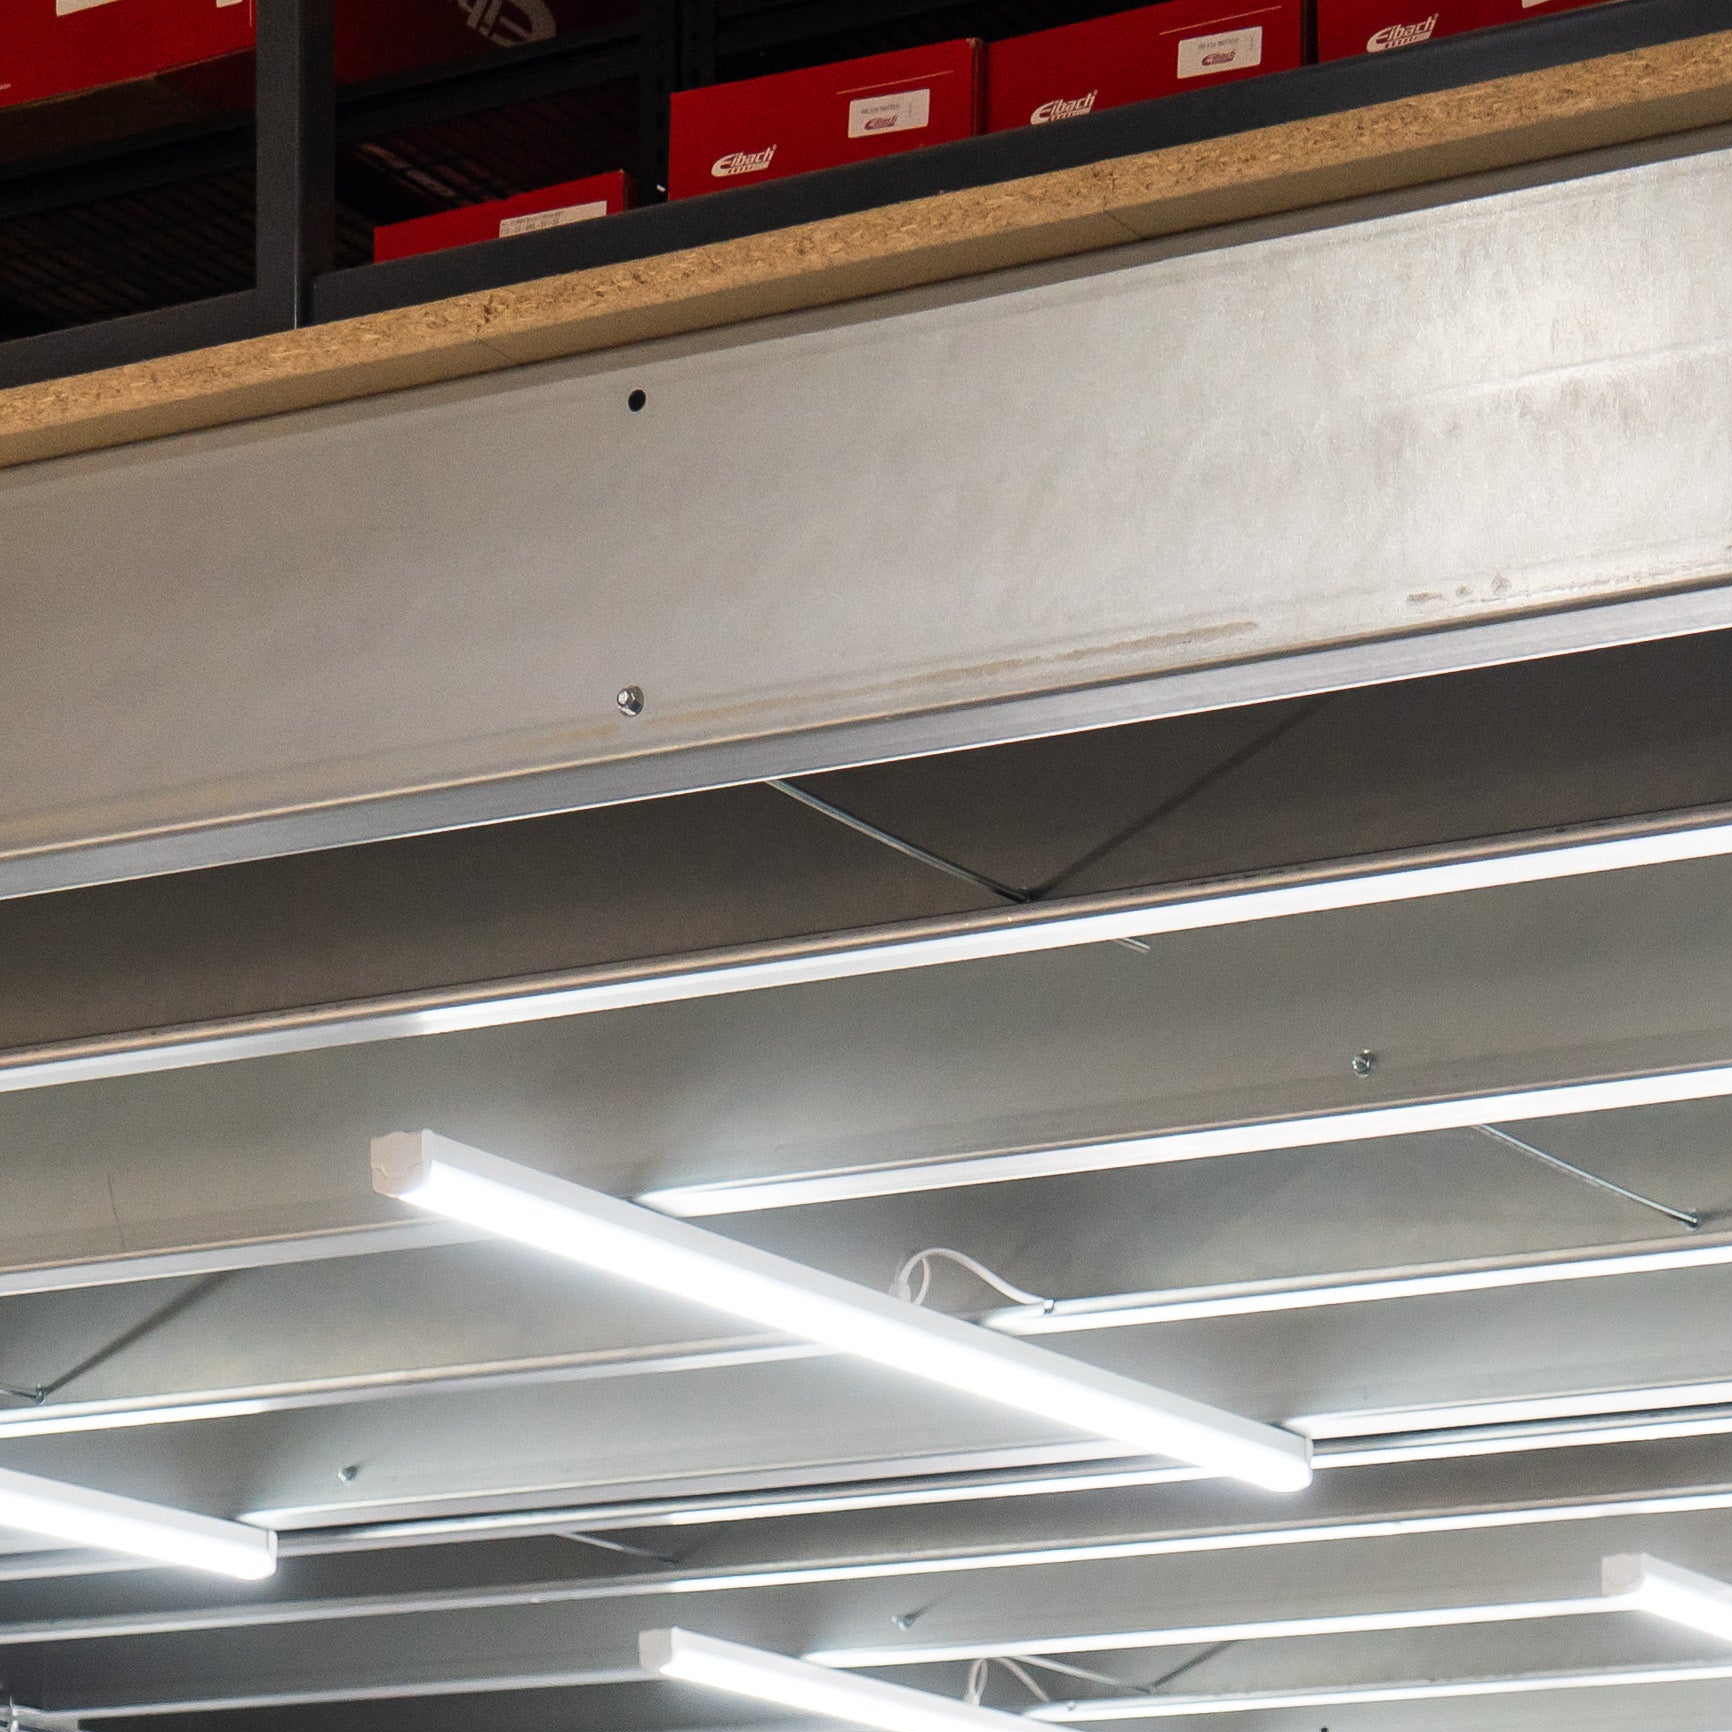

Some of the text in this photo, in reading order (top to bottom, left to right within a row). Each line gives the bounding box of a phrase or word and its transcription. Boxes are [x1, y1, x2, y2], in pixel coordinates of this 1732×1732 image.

[1366, 15, 1436, 53] Eibach
[1030, 93, 1096, 125] Eibach
[711, 146, 776, 177] Eibach
